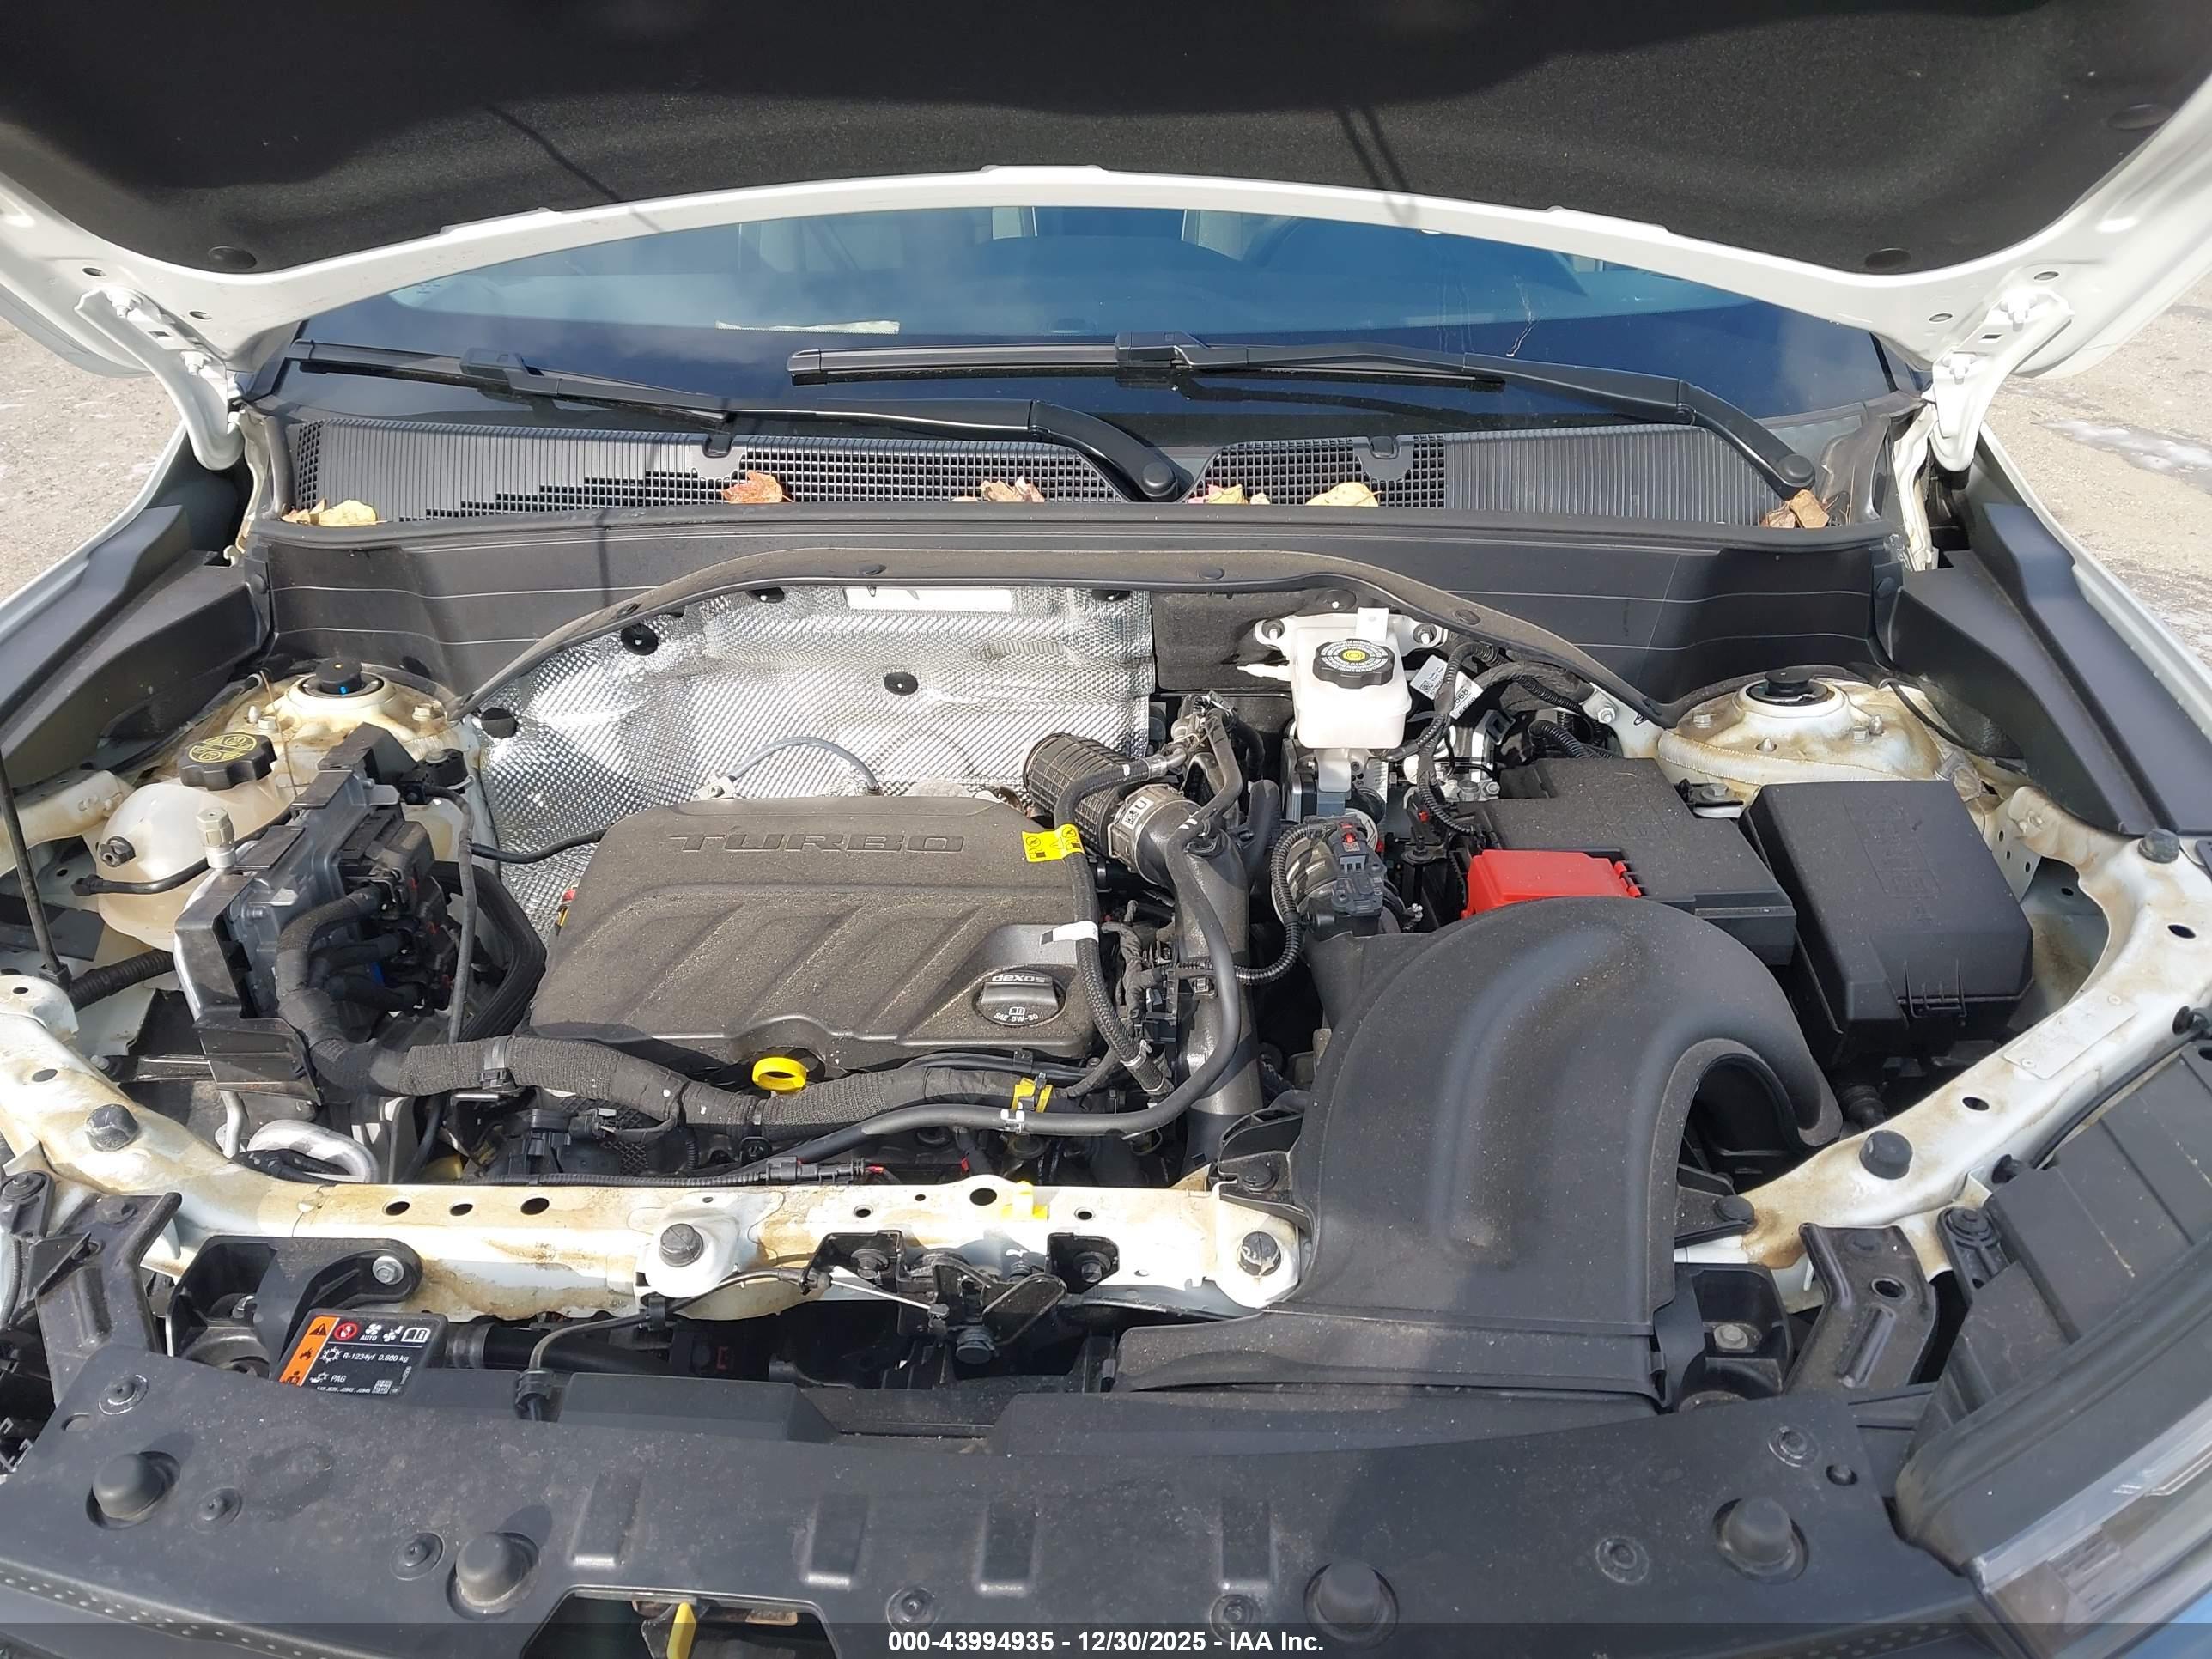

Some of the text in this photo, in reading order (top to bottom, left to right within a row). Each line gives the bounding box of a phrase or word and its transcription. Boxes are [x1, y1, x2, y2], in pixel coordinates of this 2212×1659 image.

[669, 834, 964, 853] TURBO
[991, 973, 1046, 983] dexos
[993, 1012, 1009, 1022] SAE
[343, 1352, 376, 1362] R-1234yf
[399, 1355, 410, 1364] kg
[330, 1374, 347, 1382] PAG
